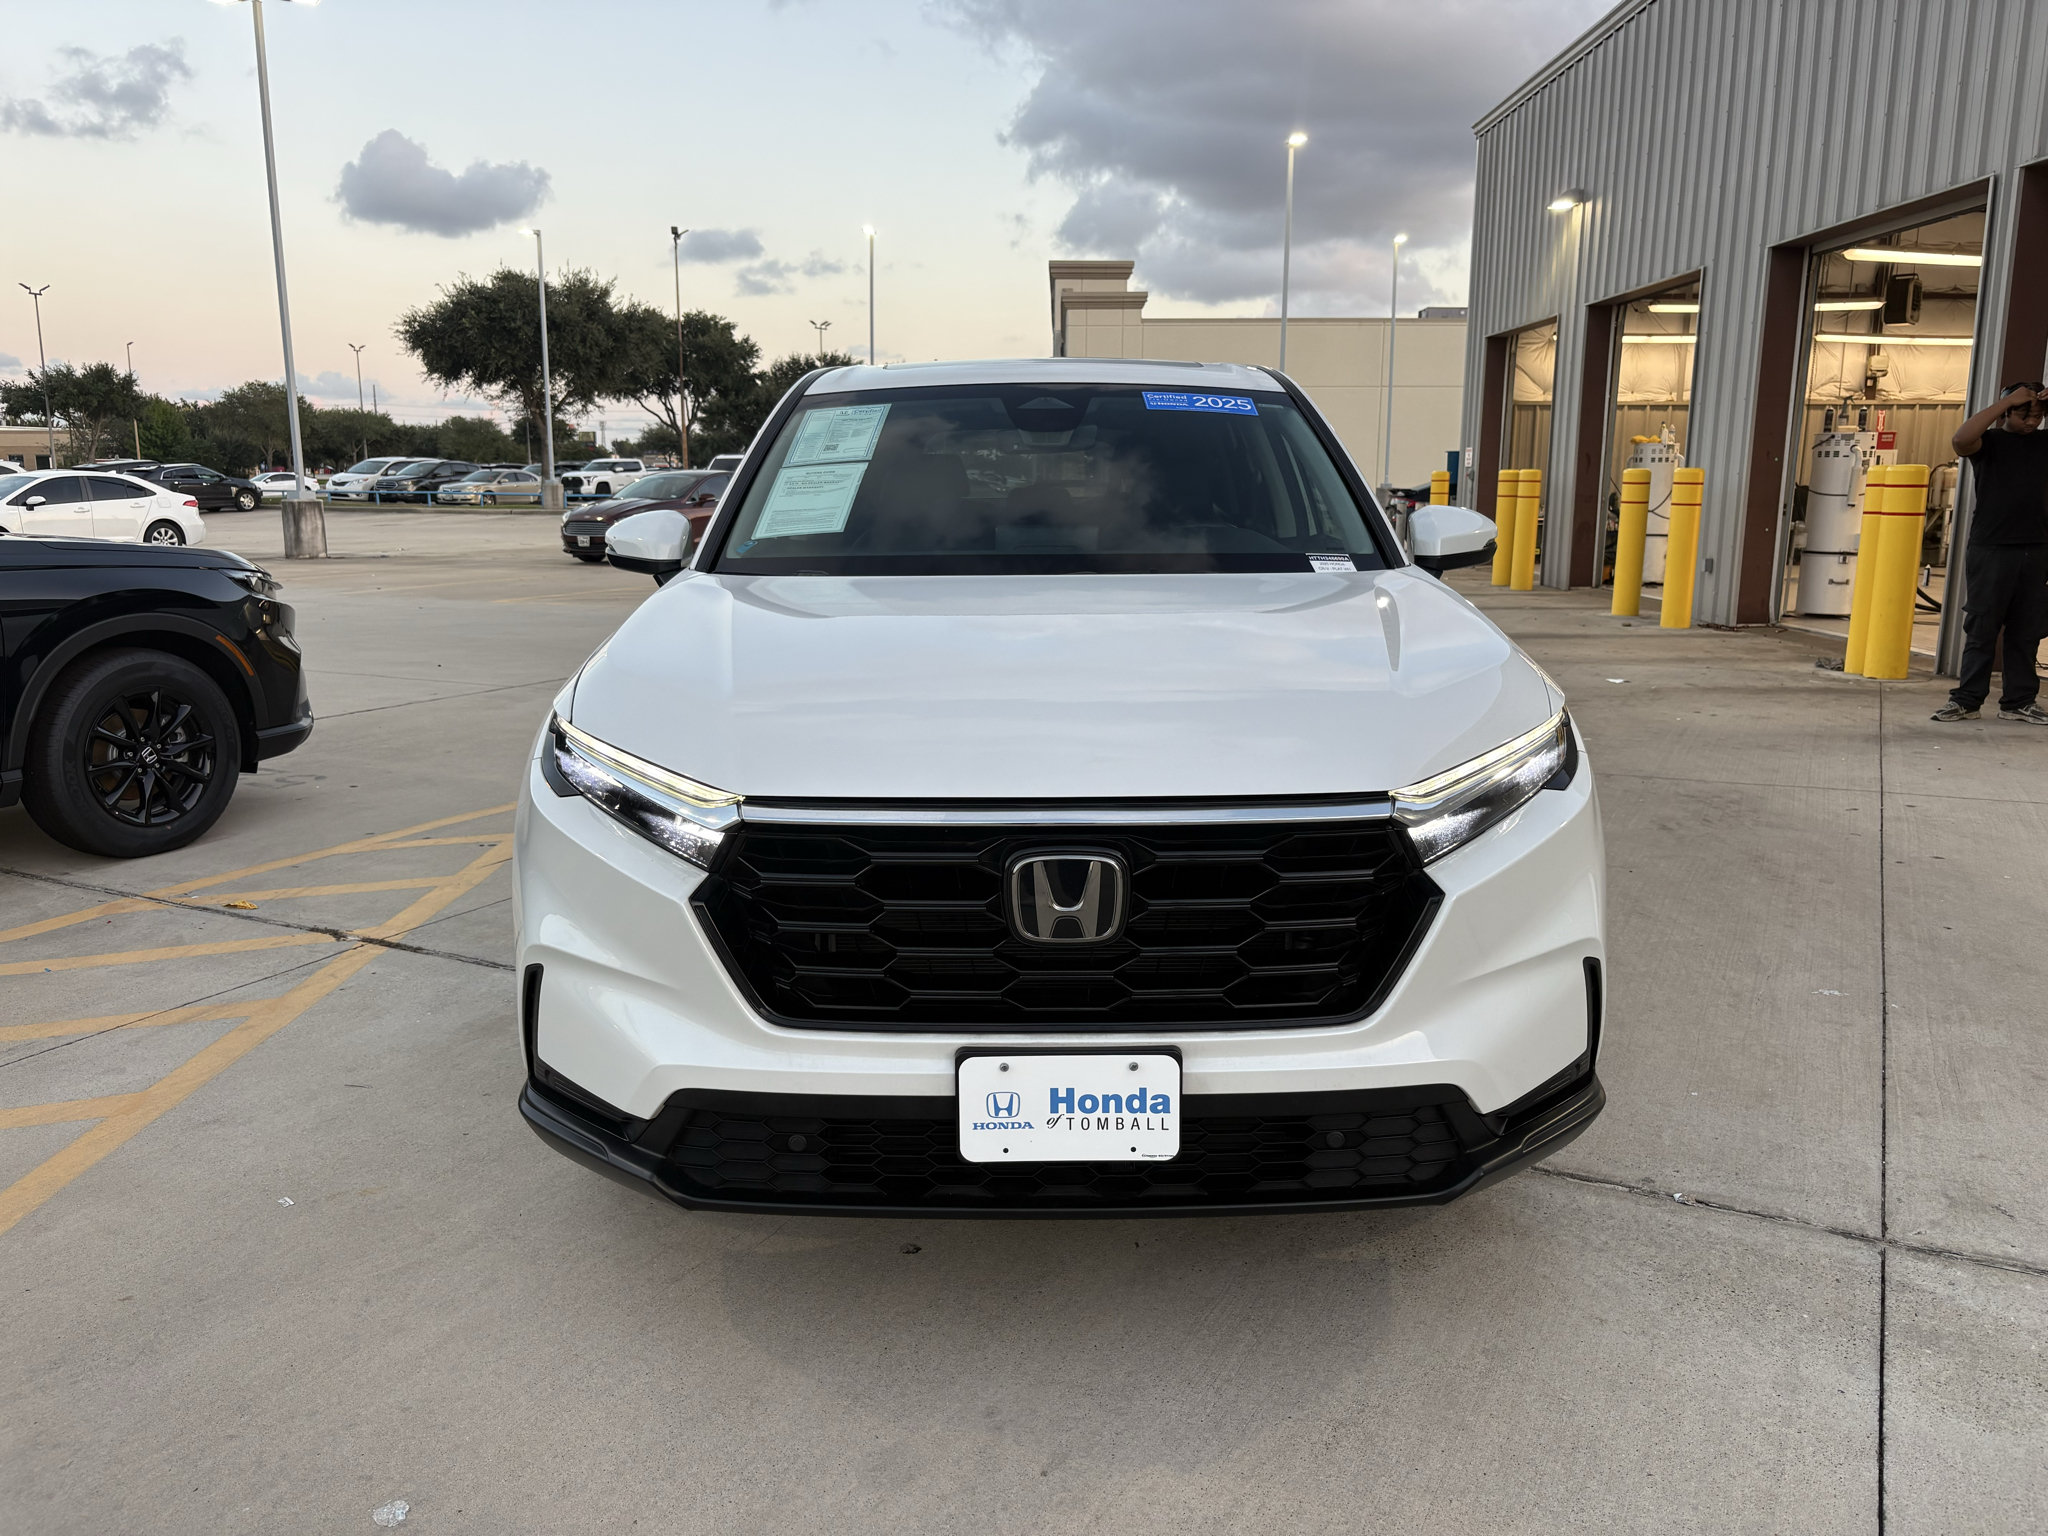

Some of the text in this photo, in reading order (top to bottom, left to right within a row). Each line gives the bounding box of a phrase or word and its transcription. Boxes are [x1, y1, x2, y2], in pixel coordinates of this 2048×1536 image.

[1192, 396, 1252, 410] 2025
[1049, 1087, 1171, 1114] Honda
[972, 1121, 1035, 1131] HONDA
[1046, 1113, 1170, 1131] of TOMBALL
